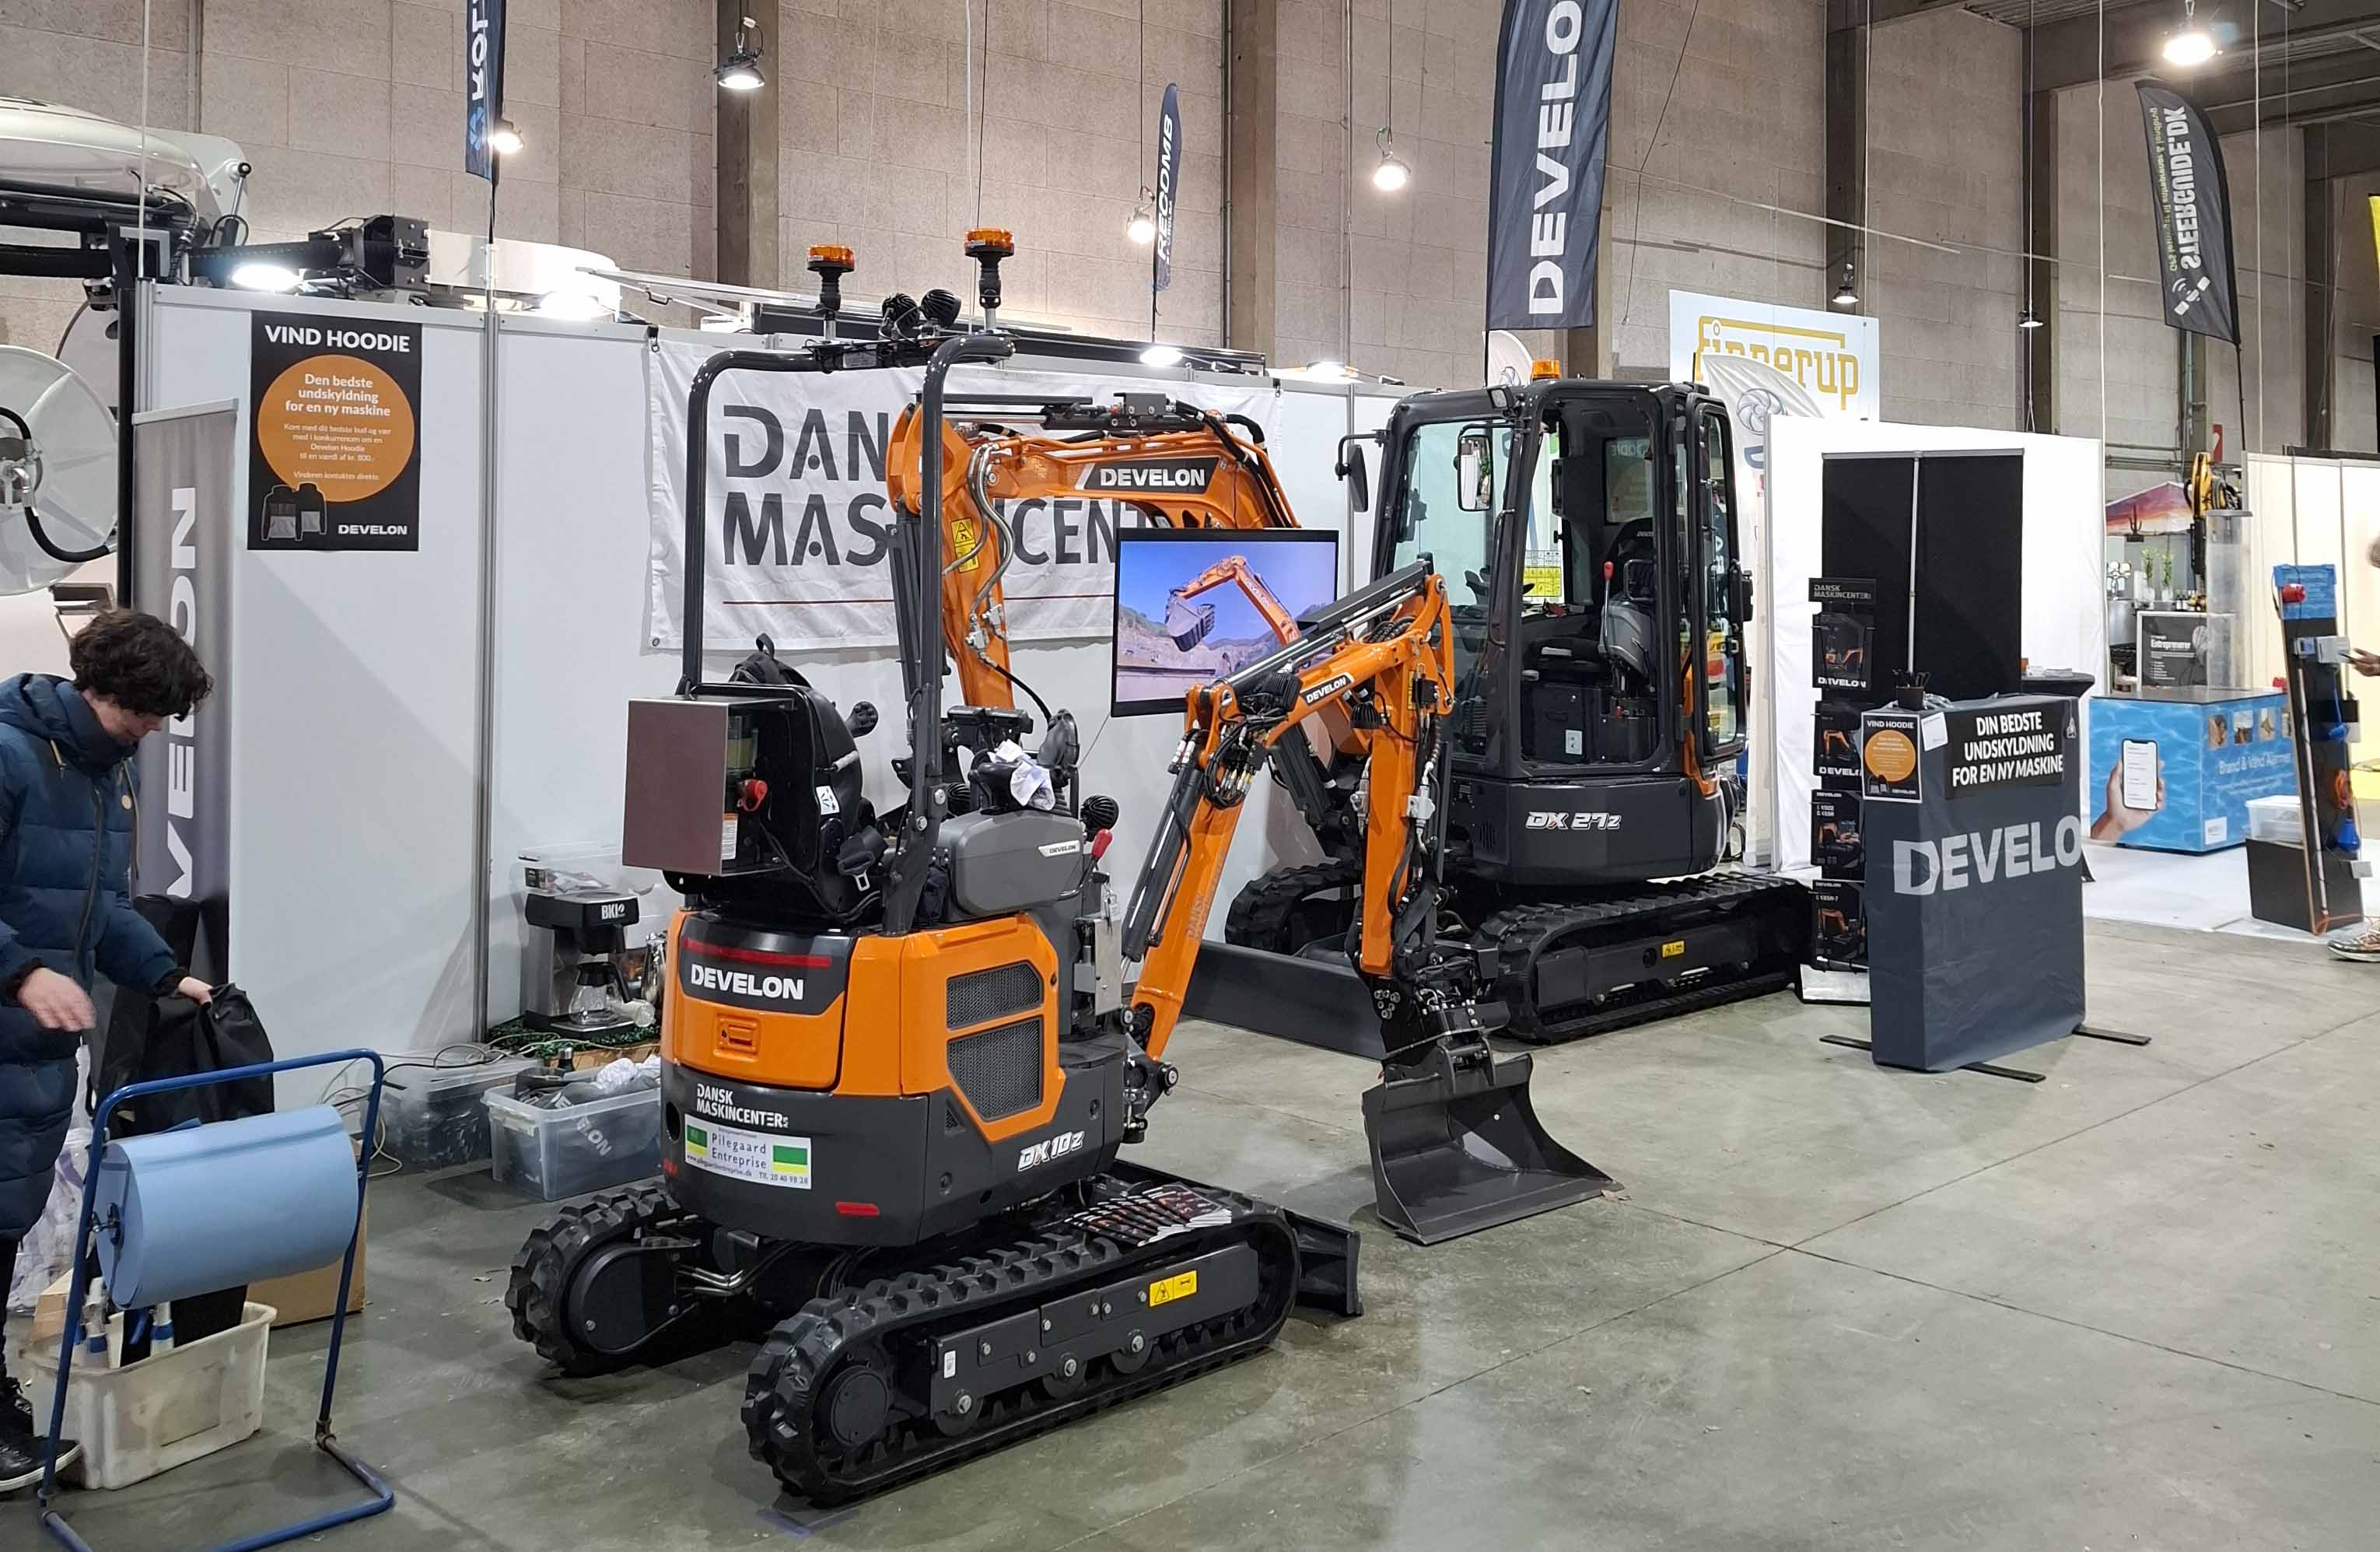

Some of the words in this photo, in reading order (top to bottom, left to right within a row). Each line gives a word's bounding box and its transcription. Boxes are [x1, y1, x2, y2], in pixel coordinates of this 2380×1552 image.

[1157, 114, 1173, 261] RECOMB
[264, 325, 322, 345] VIND
[327, 329, 411, 352] HOODIE
[304, 373, 330, 386] Den
[332, 375, 373, 388] bedste
[298, 388, 379, 405] undskyldning
[285, 401, 303, 412] for
[306, 403, 321, 412] en
[324, 405, 338, 416] ny
[341, 405, 391, 416] maskine
[1100, 468, 1205, 486] DEVELON
[338, 524, 408, 535] DEVELON
[1307, 676, 1347, 704] DEVELON
[1885, 720, 1915, 729] HOODIE
[1976, 716, 1998, 737] DIN
[1999, 712, 2043, 734] BEDSTE
[1964, 733, 2054, 761] UNDSKYLDNING
[1952, 766, 1978, 787] FOR
[1979, 762, 1996, 783] EN
[1997, 761, 2015, 780] NY
[2014, 755, 2063, 779] MASKINE
[1525, 811, 1570, 830] DX
[1049, 844, 1076, 853] DEVELON
[601, 903, 618, 920] BKI
[691, 963, 804, 1000] DEVELON
[697, 1083, 733, 1105] DANSK
[696, 1098, 783, 1128] MASKINCENTER
[712, 1133, 767, 1154] Pilegaard
[712, 1147, 767, 1169] Entreprise
